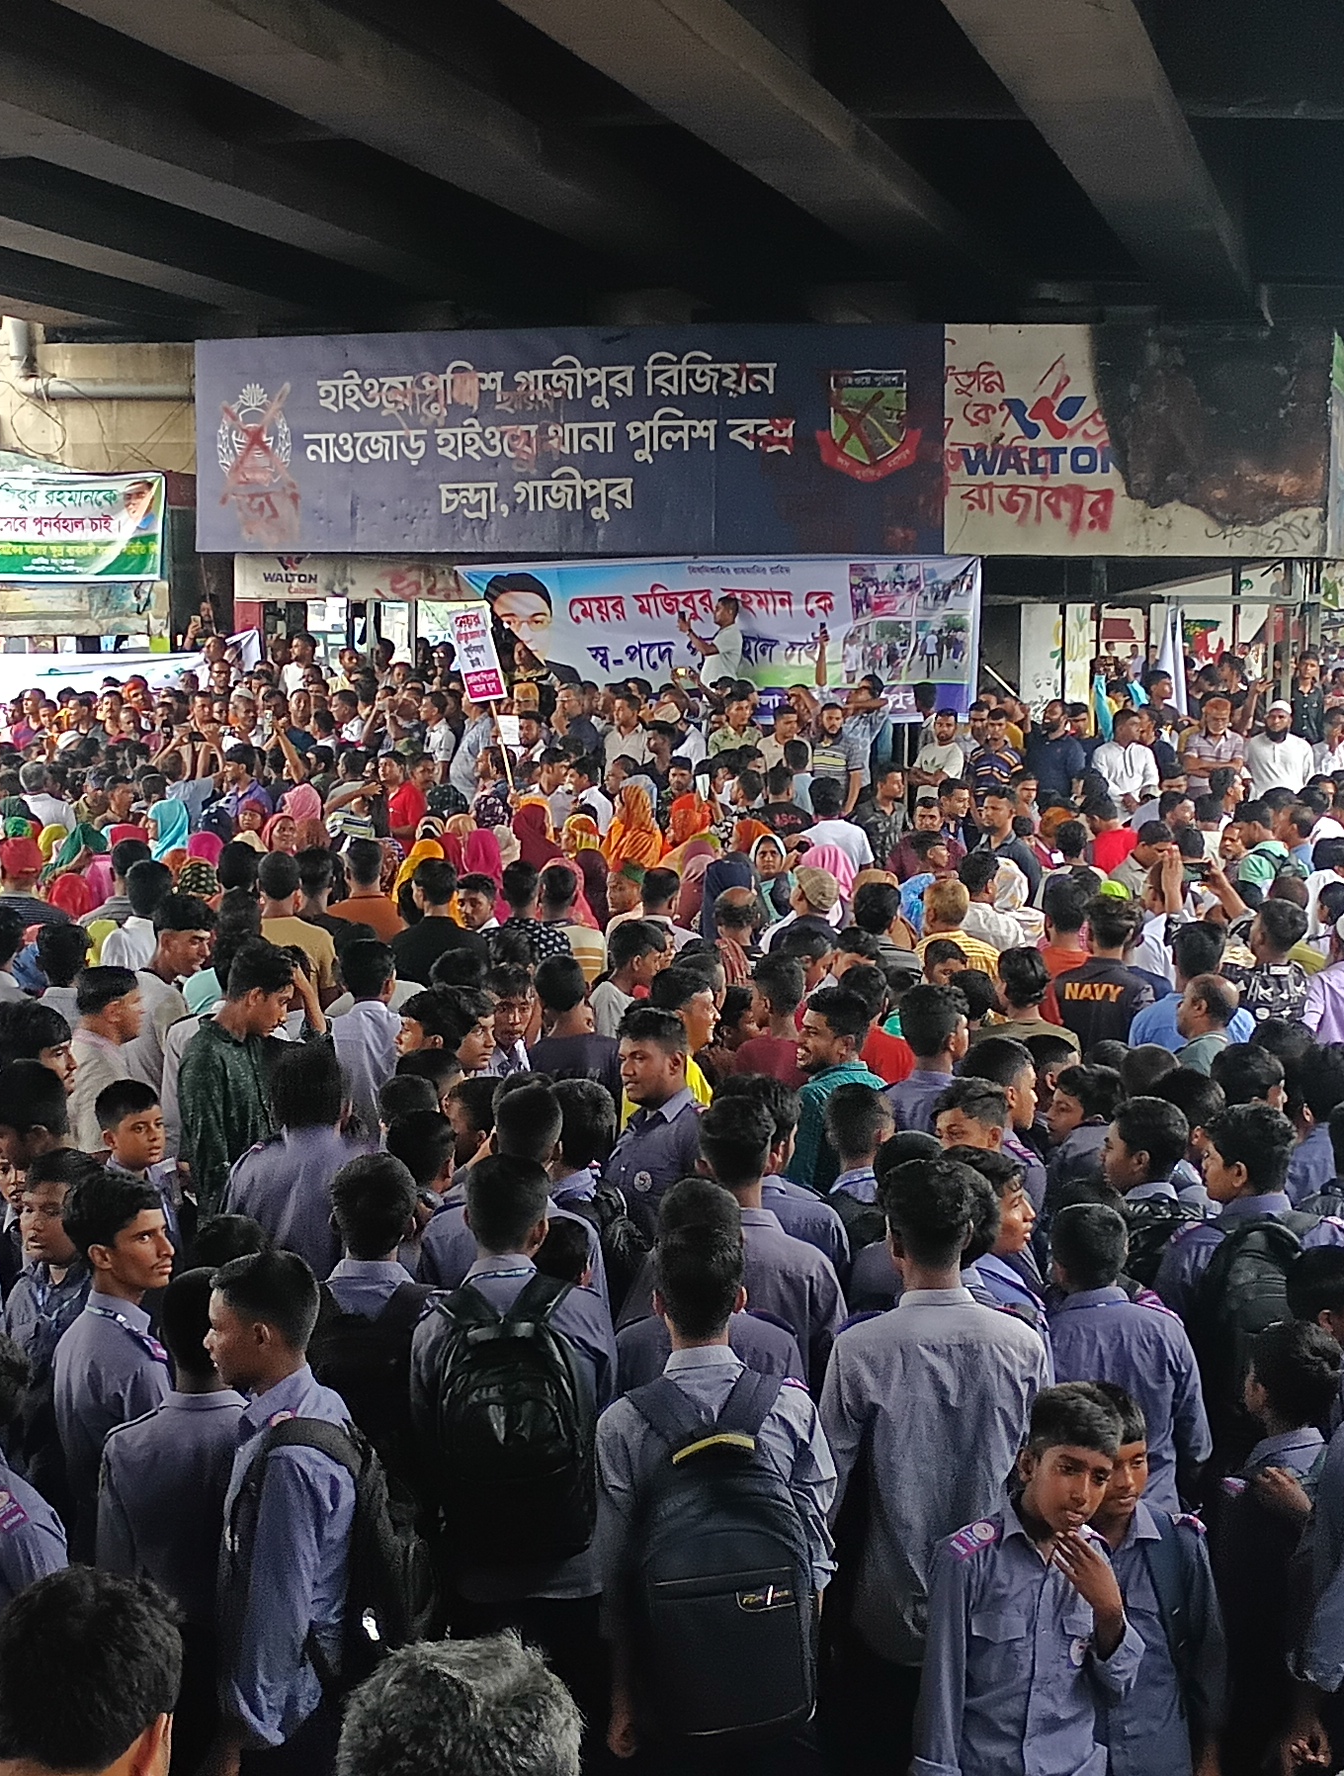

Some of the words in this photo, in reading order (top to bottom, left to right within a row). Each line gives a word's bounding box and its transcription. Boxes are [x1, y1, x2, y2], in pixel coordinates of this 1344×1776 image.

[514, 355, 636, 410] গাজীপুর
[644, 350, 778, 398] রিজিয়ন
[303, 430, 428, 466] নাওজোড়
[548, 420, 617, 455] থানা
[625, 407, 718, 464] পুলিশ
[44, 489, 121, 508] রহমানকে
[513, 466, 634, 522] গাজীপুর
[262, 572, 318, 583] WALTON
[568, 595, 626, 625] মেয়র
[632, 583, 714, 622] মজিবুর
[804, 590, 836, 619] কে
[1064, 981, 1125, 1003] NAVY
